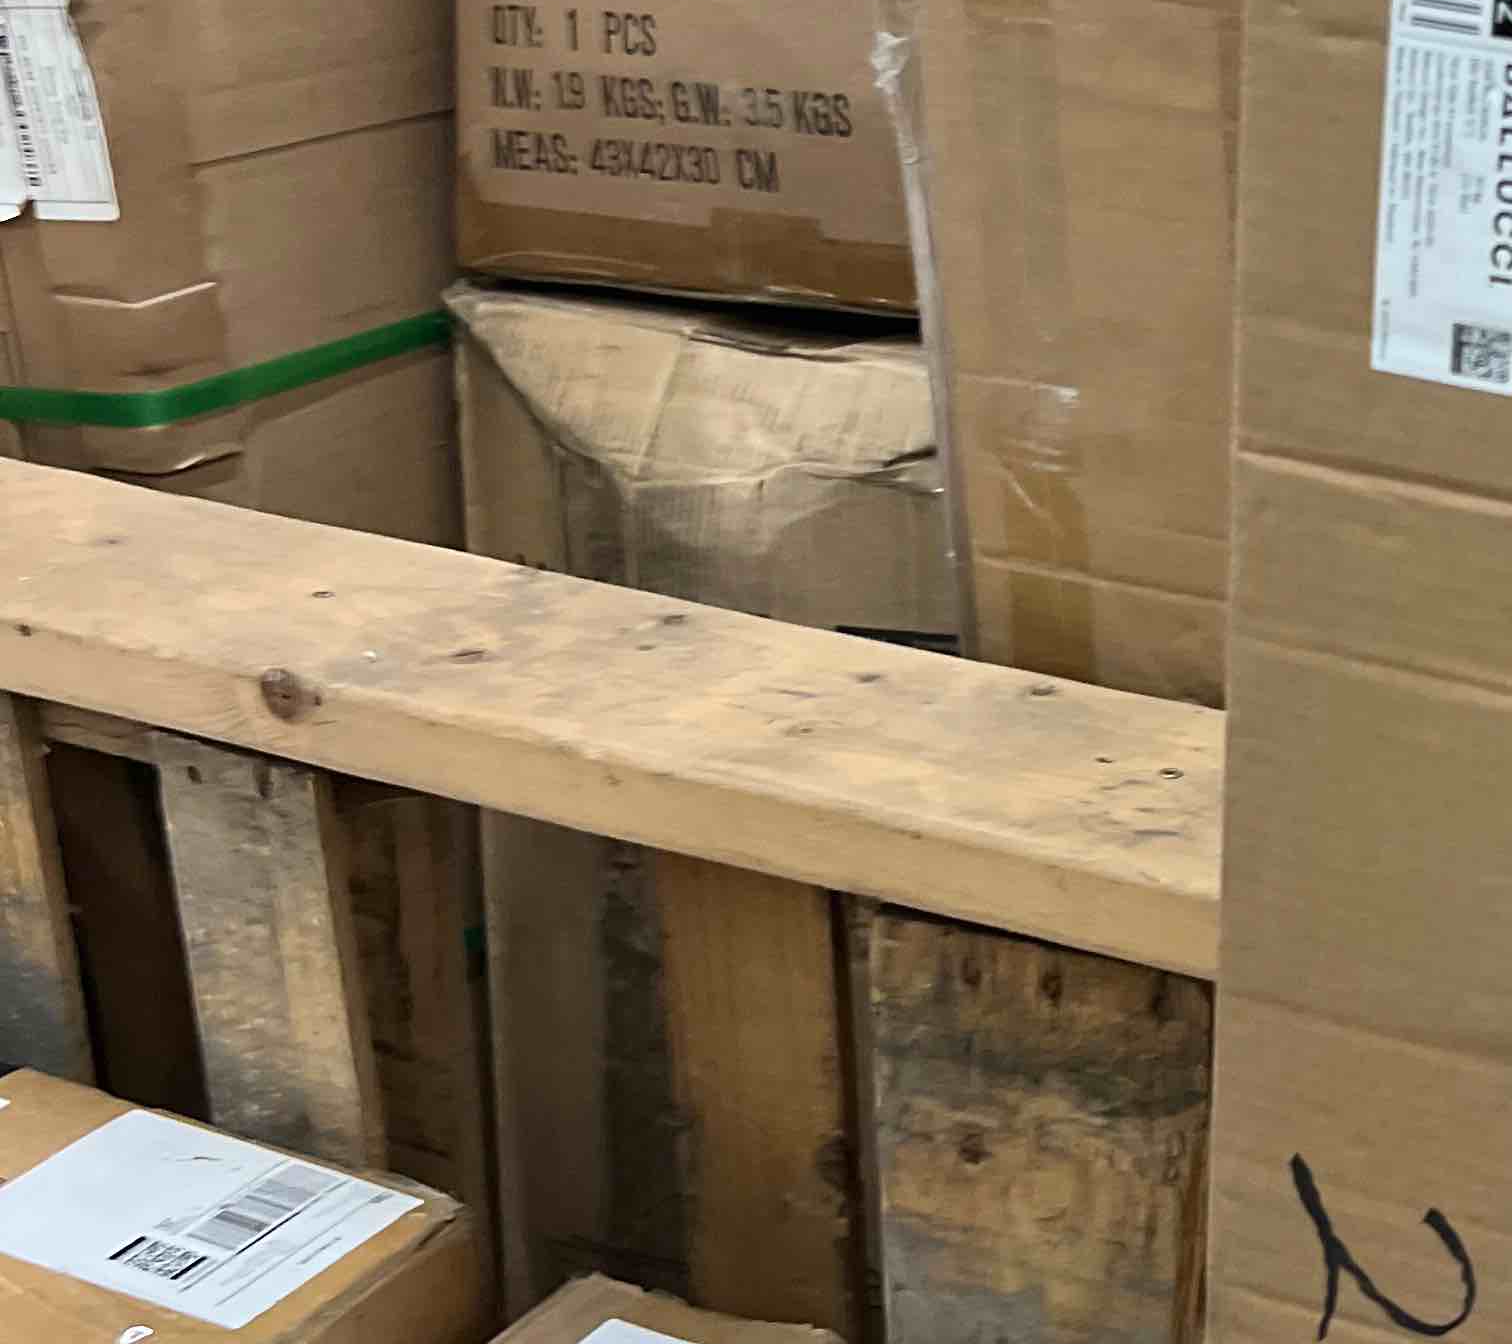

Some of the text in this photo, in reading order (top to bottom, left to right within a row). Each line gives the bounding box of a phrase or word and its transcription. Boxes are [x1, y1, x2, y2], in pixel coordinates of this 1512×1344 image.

[492, 5, 656, 56] QTY: 1 PCS
[791, 89, 852, 138] KGS
[491, 129, 578, 175] MEAS:
[735, 147, 781, 193] CM
